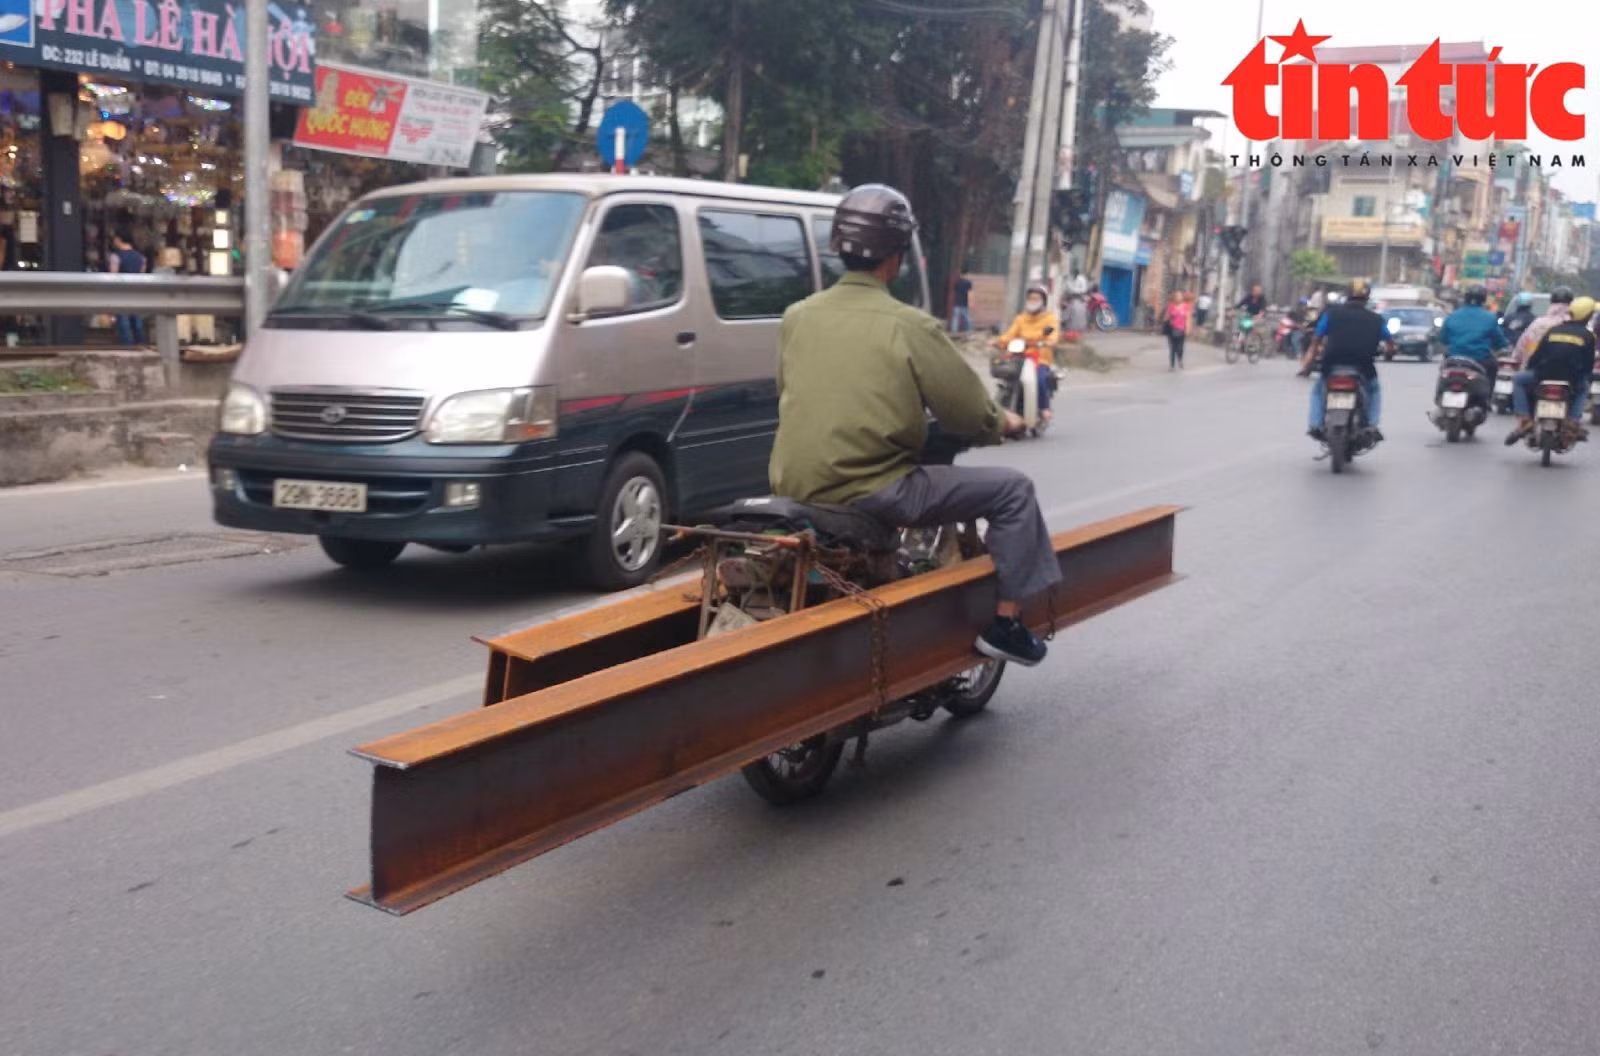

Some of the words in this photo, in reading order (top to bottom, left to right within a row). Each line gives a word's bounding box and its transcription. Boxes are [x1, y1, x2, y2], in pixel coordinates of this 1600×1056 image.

[39, 0, 125, 42] PHA
[134, 0, 182, 51] LÊ
[191, 4, 245, 62] HÀ
[266, 18, 311, 81] ỘI
